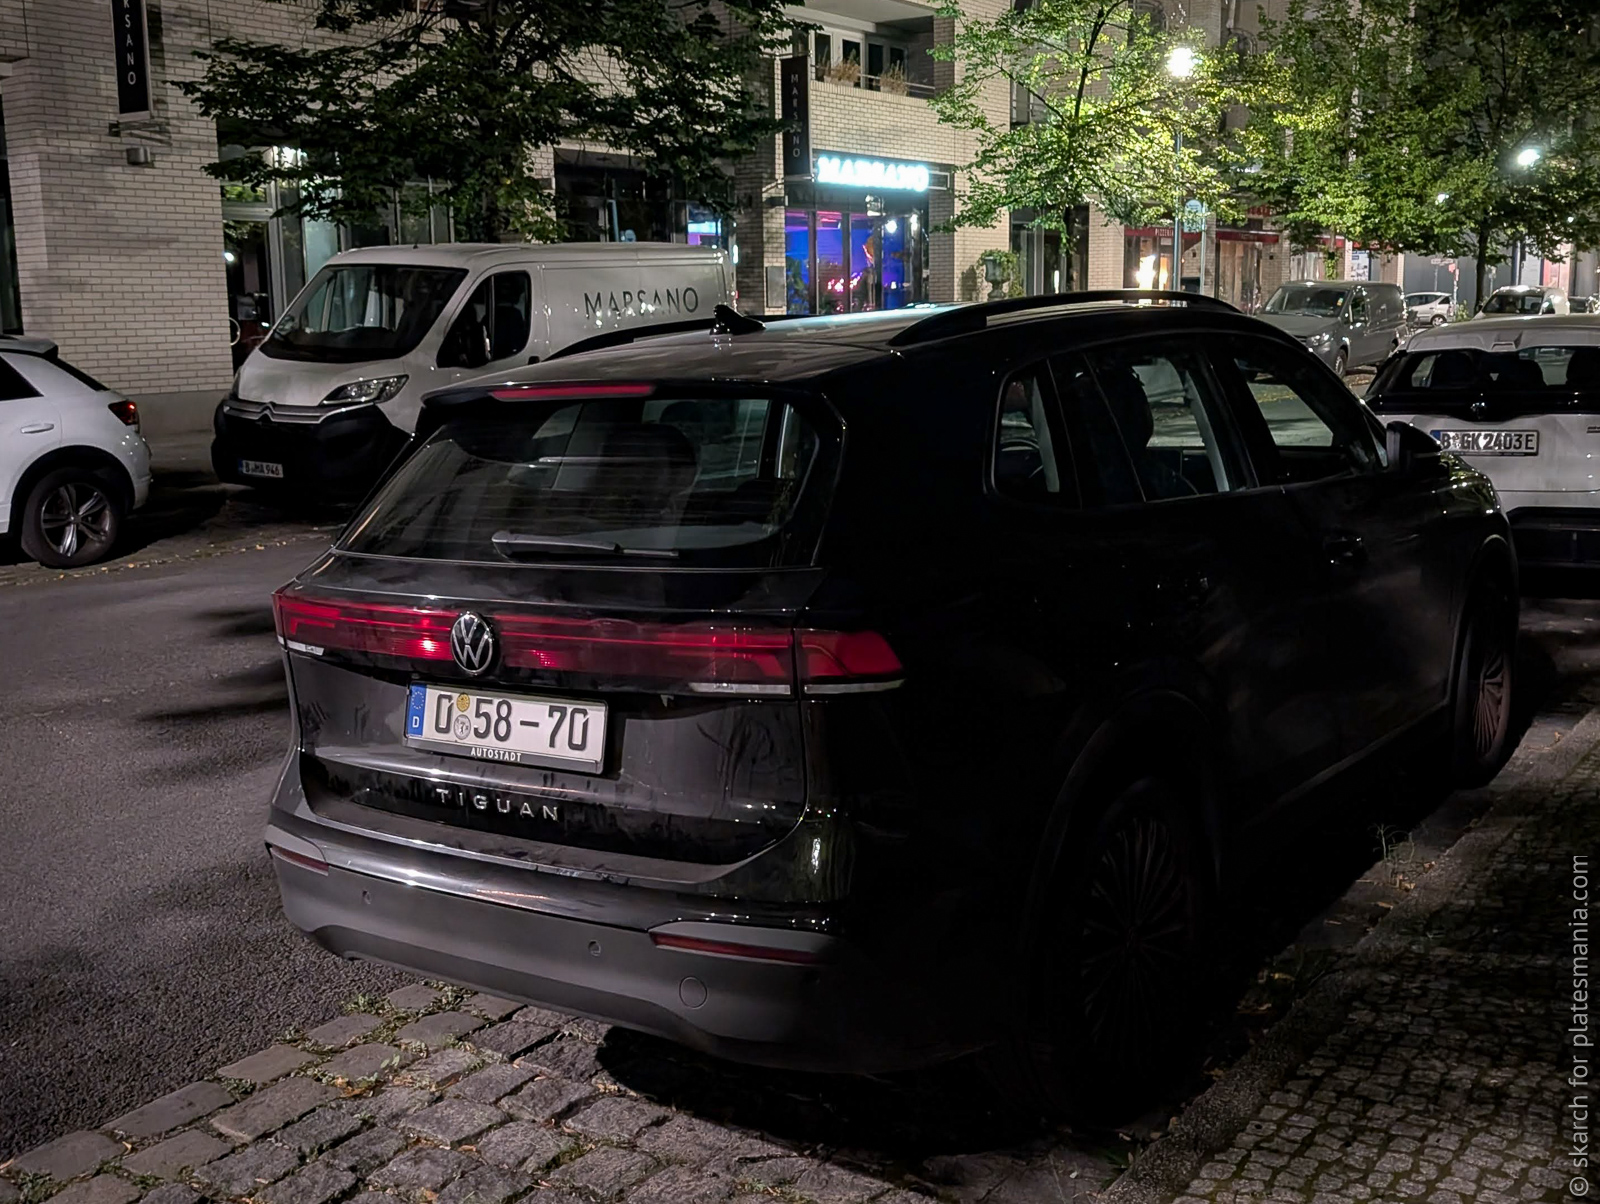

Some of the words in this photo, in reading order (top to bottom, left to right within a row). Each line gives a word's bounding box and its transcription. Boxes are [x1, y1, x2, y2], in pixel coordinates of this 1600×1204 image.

[791, 74, 801, 157] MARSNO
[470, 747, 522, 762] AUTOSTADT
[436, 788, 558, 821] TIGUAN
